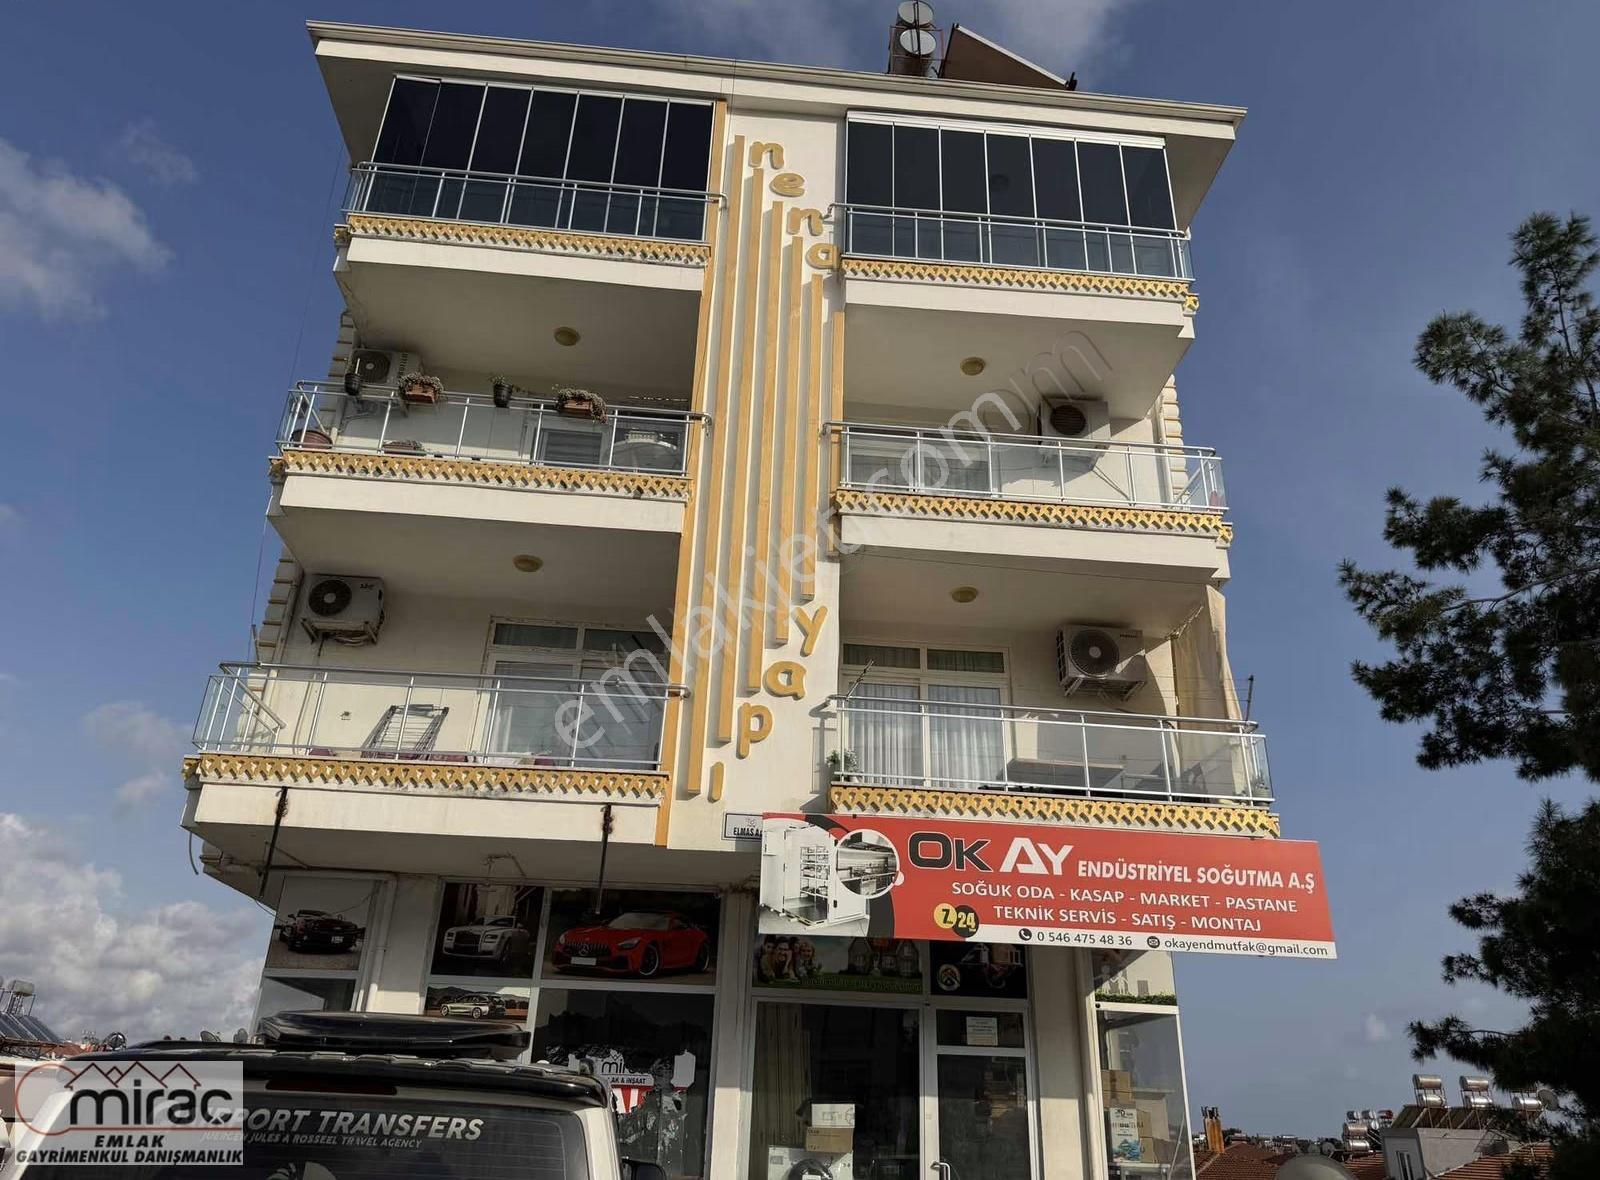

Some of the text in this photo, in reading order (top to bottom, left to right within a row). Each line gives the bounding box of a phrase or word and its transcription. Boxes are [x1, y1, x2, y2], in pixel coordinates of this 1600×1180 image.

[907, 830, 1315, 894] OK AY ENDÜSTRİYEL SOĞUTMA A.Ş
[951, 880, 1012, 897] SOĞUK
[1016, 885, 1055, 899] ODA
[1070, 889, 1125, 903] KASAP
[1140, 893, 1210, 908] MARKET
[1225, 897, 1298, 912] PASTANE
[993, 904, 1054, 921] TEKNİK
[1058, 907, 1117, 924] SERVİS
[1131, 913, 1176, 930] SATIŞ
[1191, 916, 1262, 932] MONTAJ
[1037, 931, 1133, 946] 0 546 475 48 36
[1164, 938, 1328, 956] okayendmutfak@gmail.com
[318, 1111, 485, 1141] TRANSFERS
[380, 1138, 423, 1149] AGENCY
